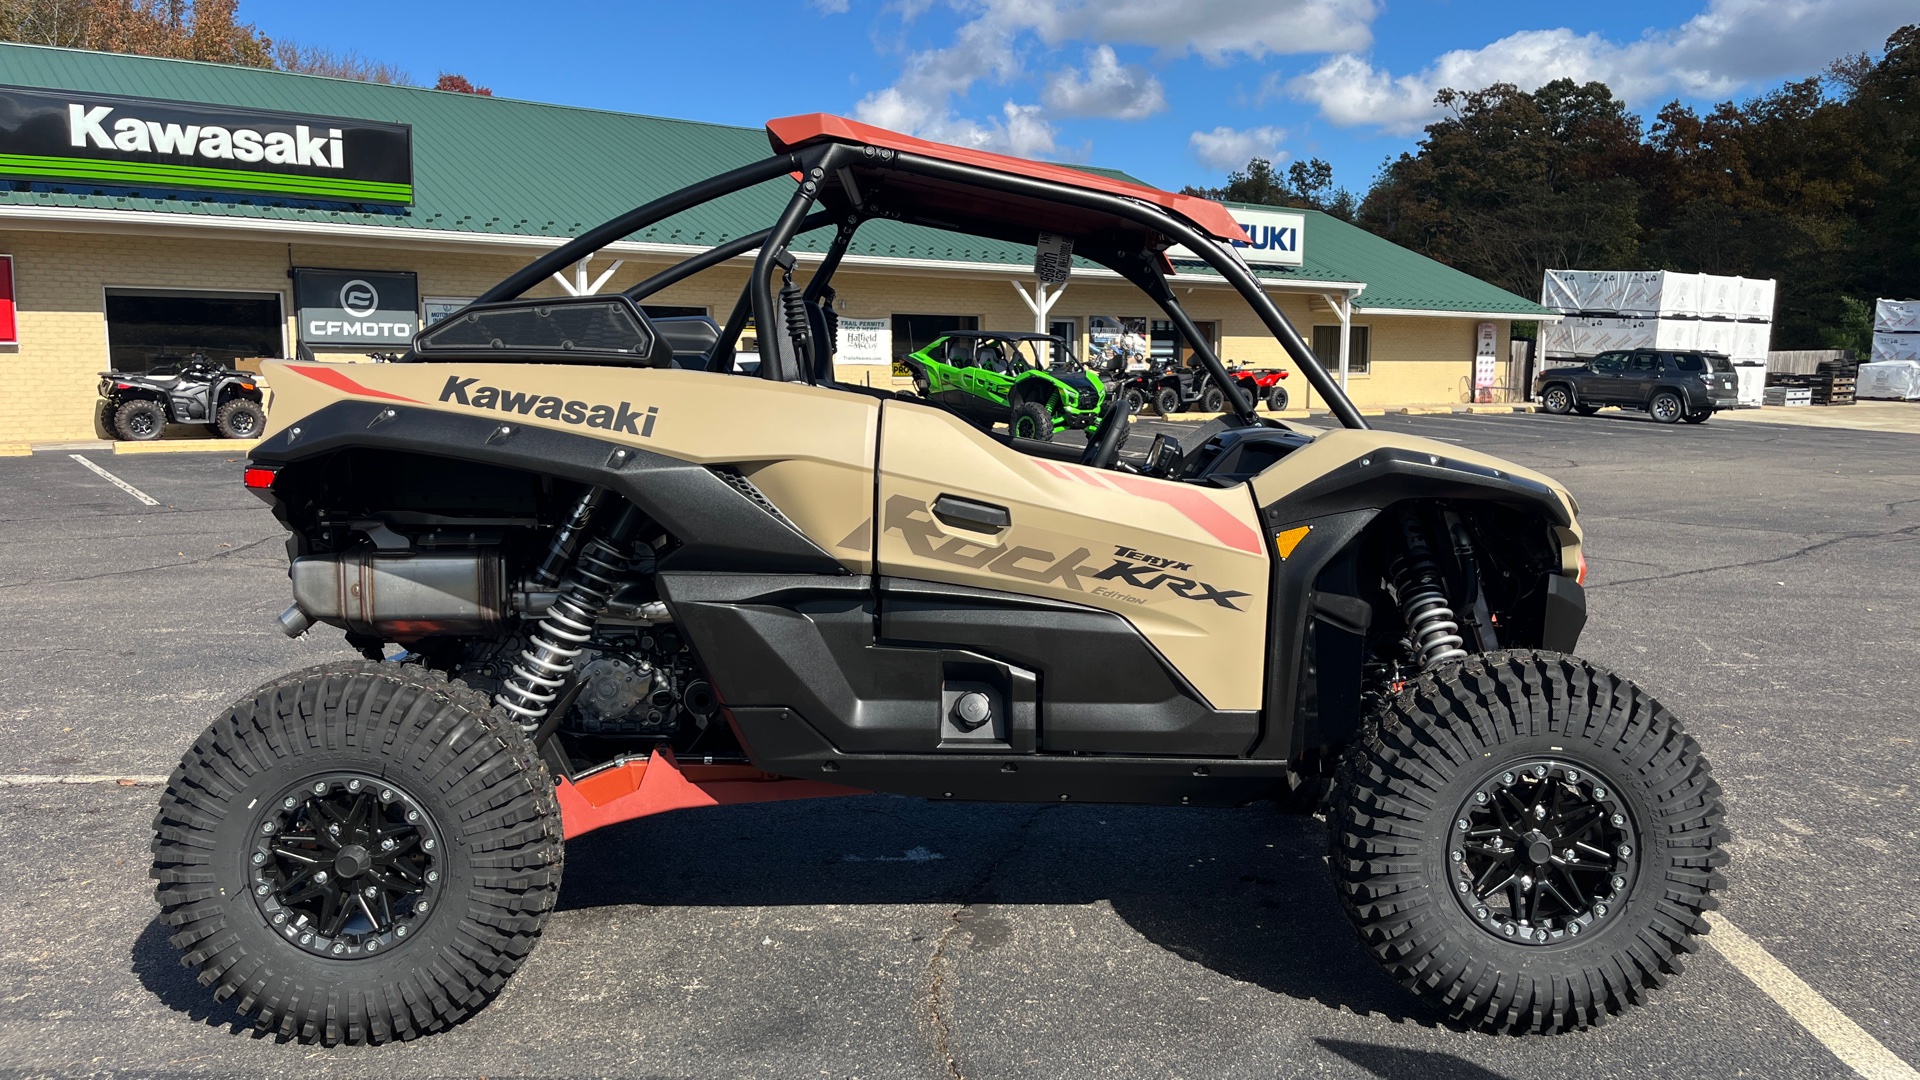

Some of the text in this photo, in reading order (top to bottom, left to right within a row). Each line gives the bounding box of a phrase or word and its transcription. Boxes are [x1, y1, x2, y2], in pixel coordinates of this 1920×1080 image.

[69, 103, 344, 169] Kawasaki
[1231, 223, 1297, 252] ZUKI
[309, 320, 411, 337] CFMOTO
[847, 333, 877, 344] Hatfield
[438, 375, 659, 438] Kawasaki
[836, 494, 1102, 592] Rock
[1092, 559, 1253, 612] KRX
